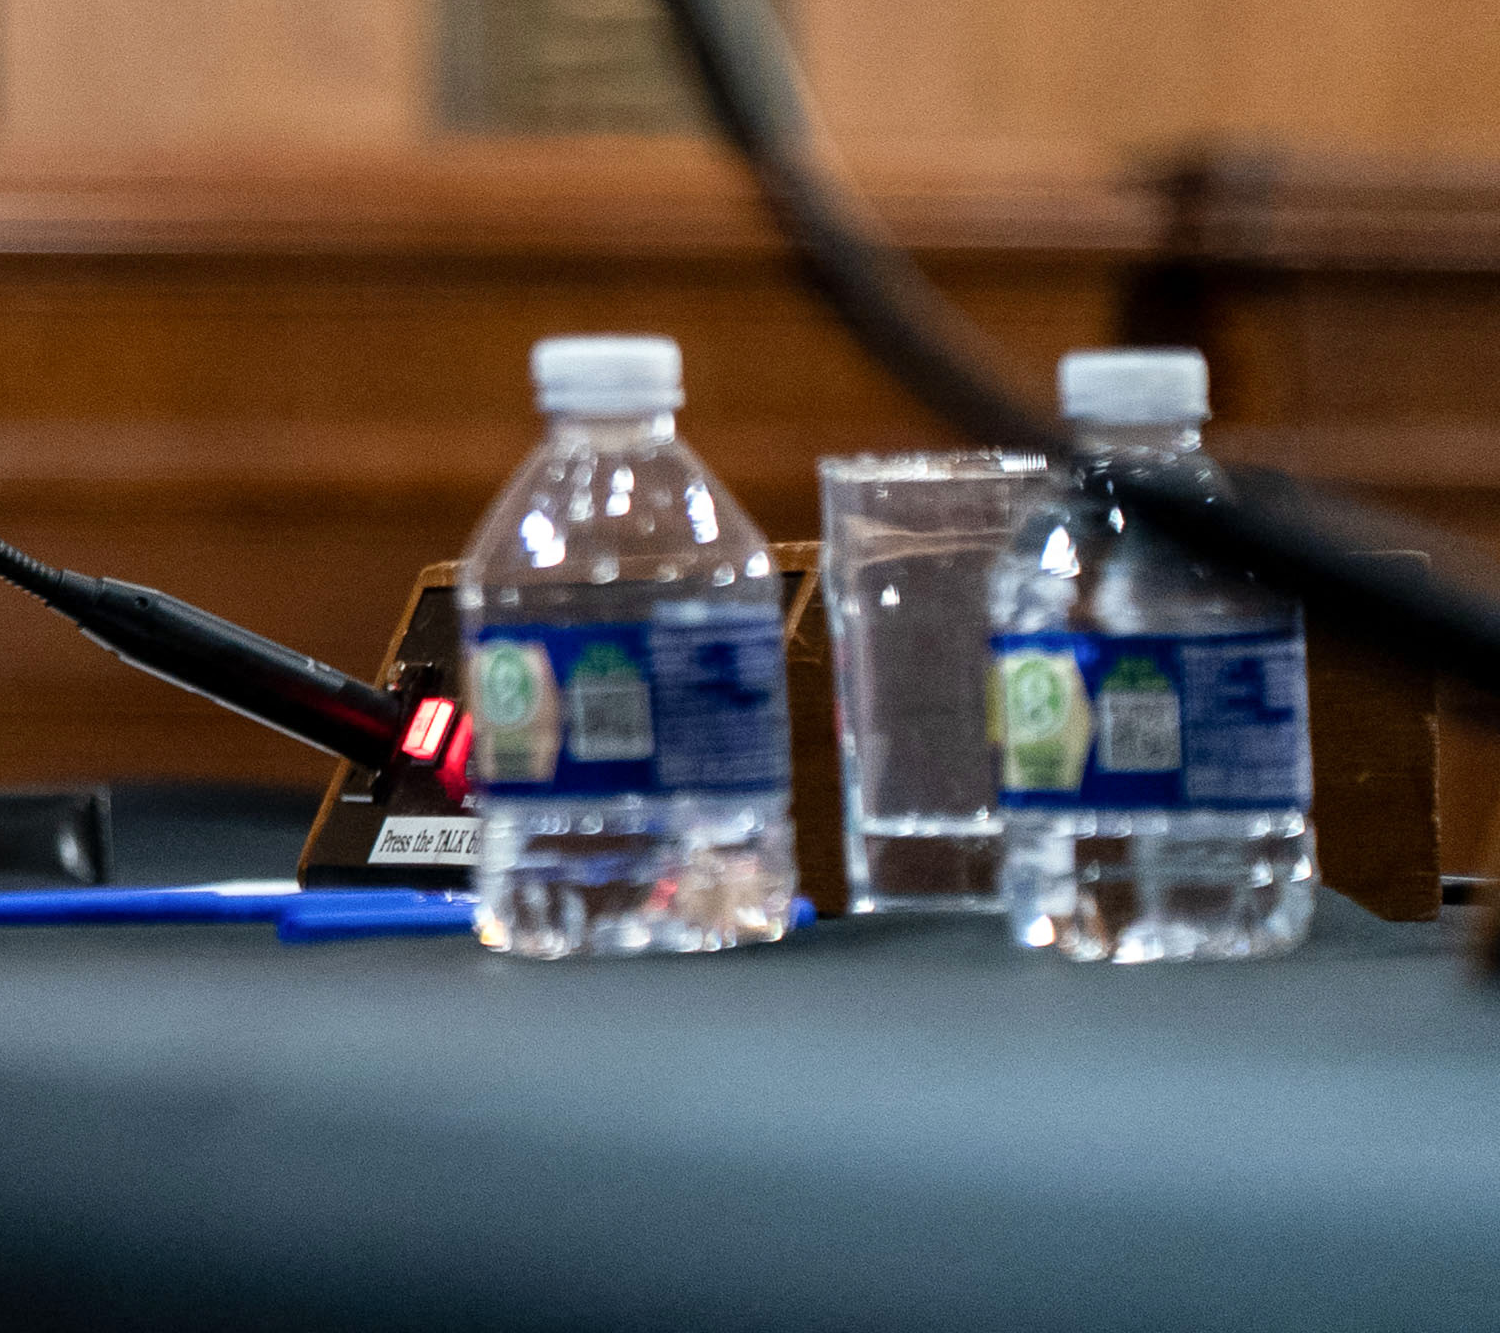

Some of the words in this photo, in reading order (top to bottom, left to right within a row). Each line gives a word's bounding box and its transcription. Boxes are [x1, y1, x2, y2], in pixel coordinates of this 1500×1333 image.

[379, 829, 412, 853] Press
[412, 829, 434, 853] the
[434, 830, 469, 853] TALK
